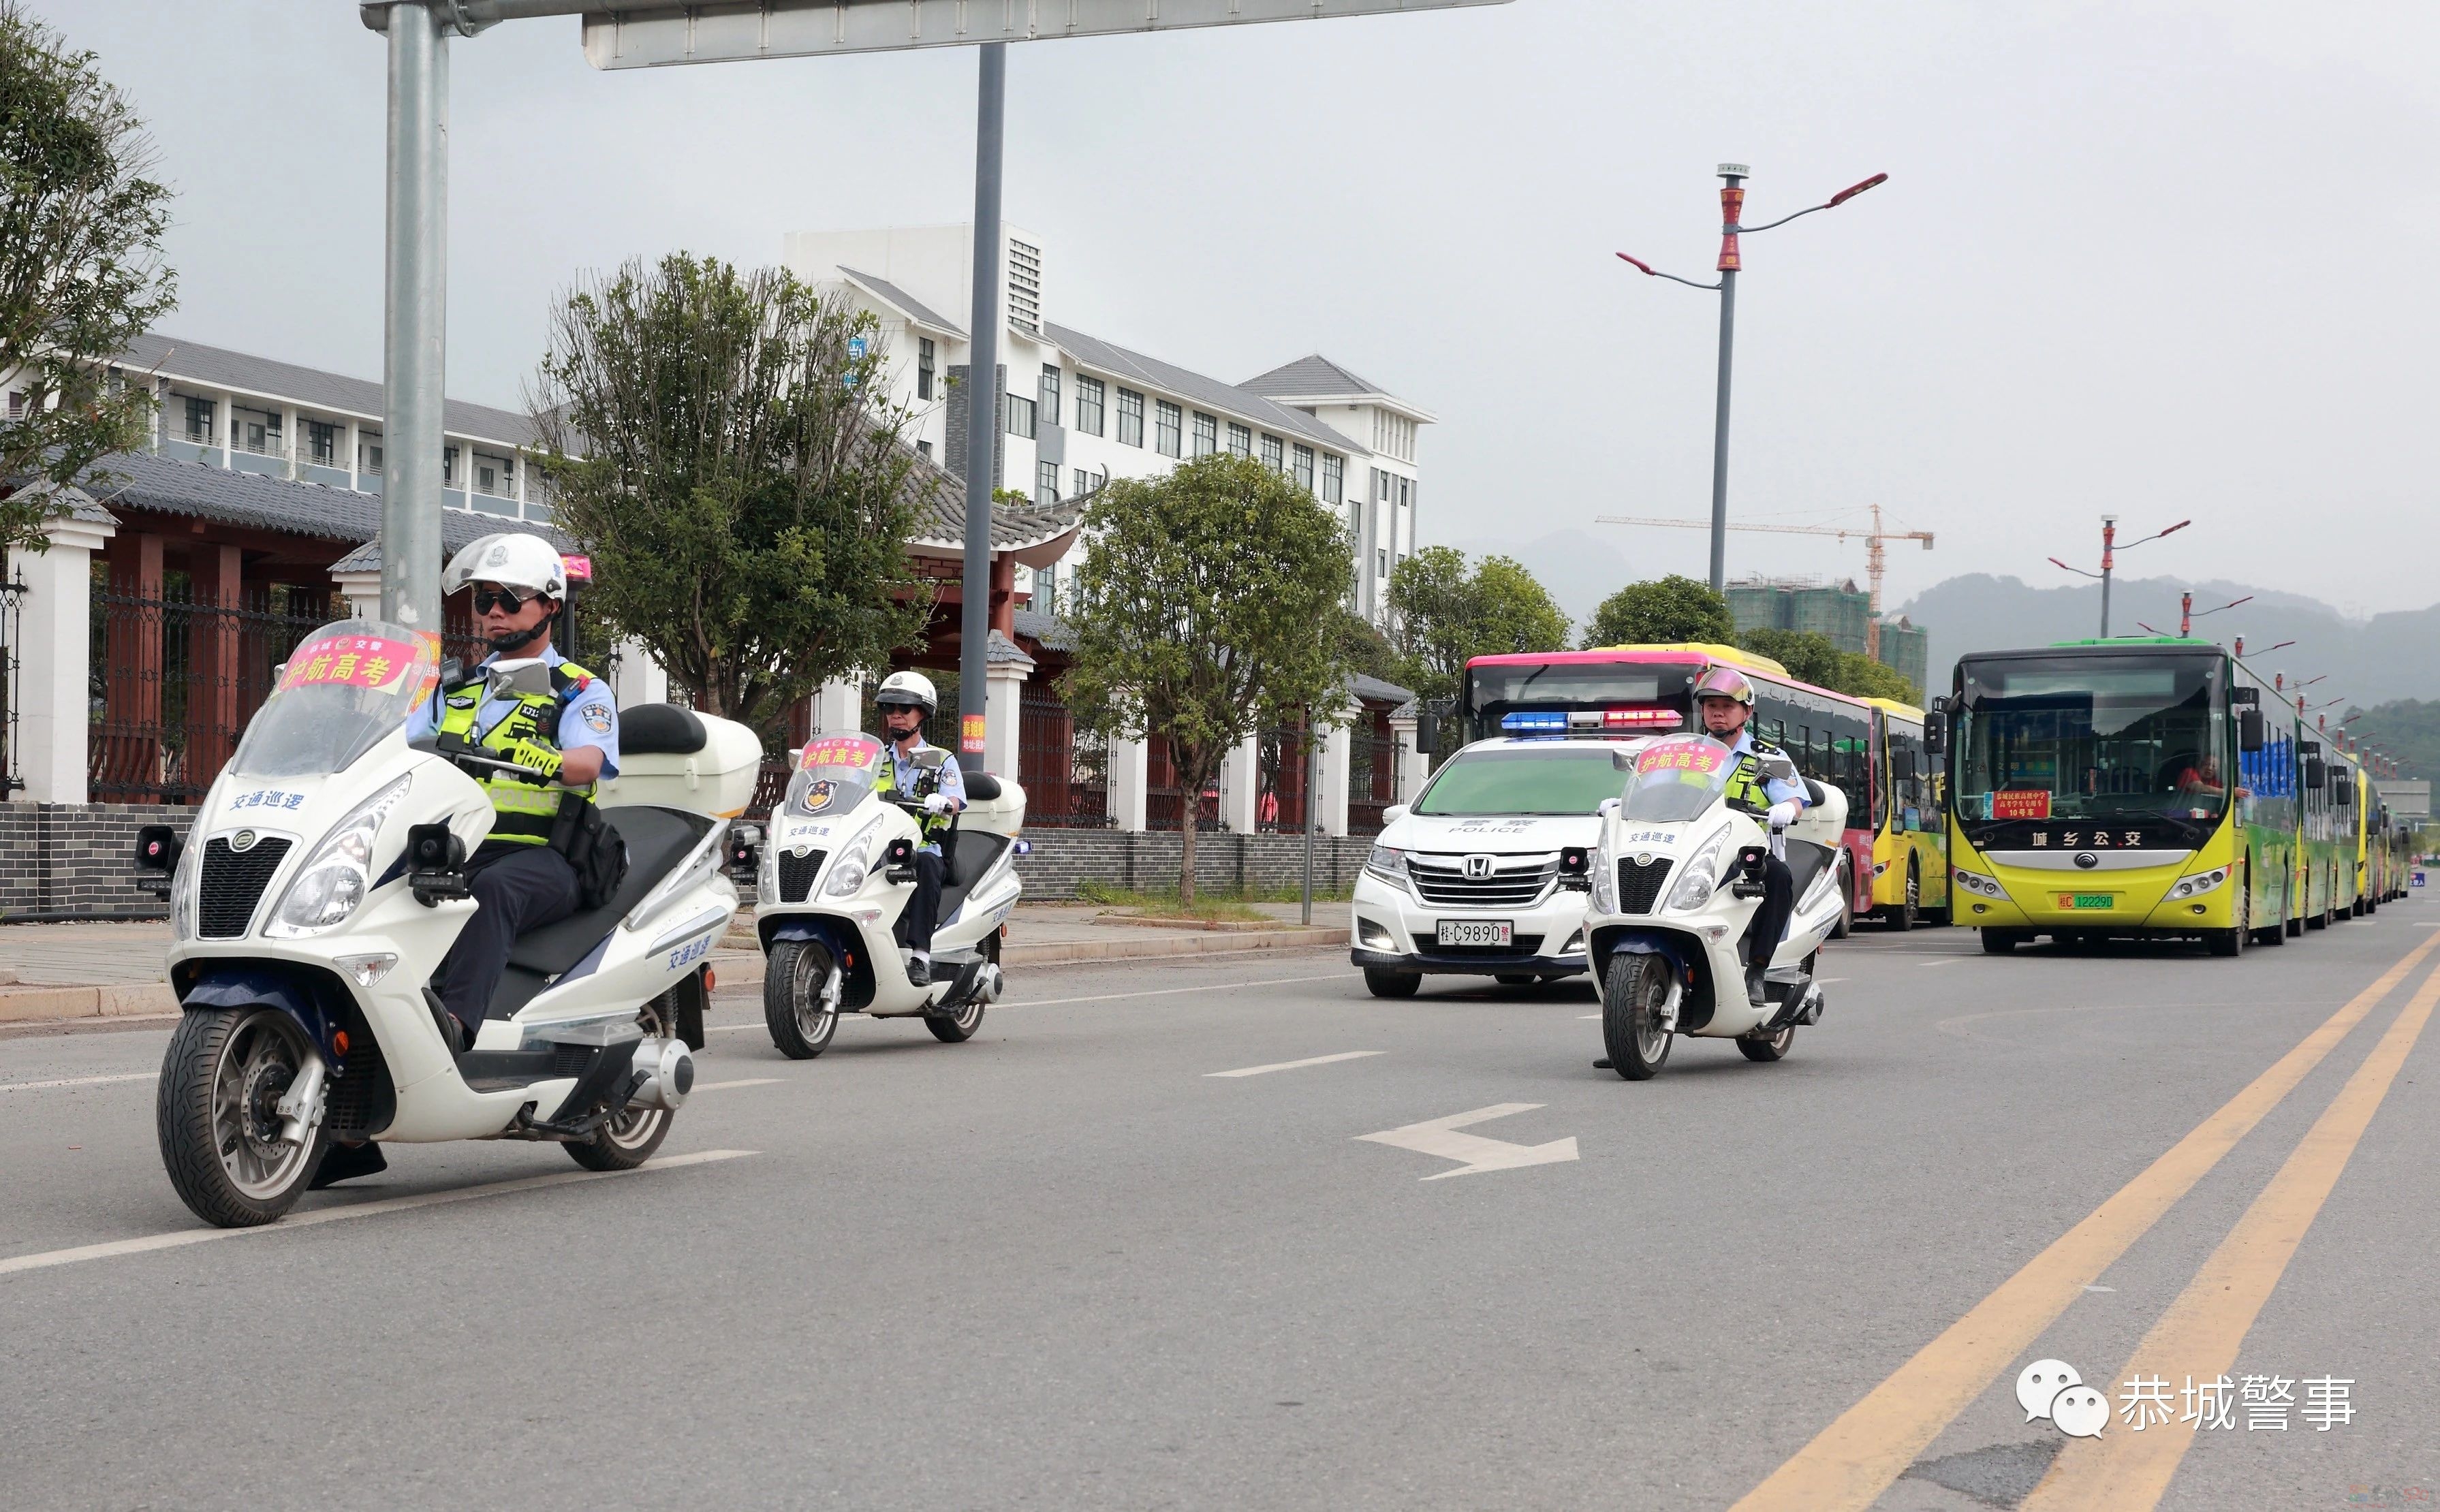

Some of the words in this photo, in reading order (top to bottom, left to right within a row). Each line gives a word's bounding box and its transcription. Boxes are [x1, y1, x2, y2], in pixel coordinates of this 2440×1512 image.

[355, 640, 383, 651] 交警
[283, 652, 390, 689] 护航高考
[804, 748, 866, 768] 护航高考
[1641, 752, 1712, 772] 护航高考
[229, 790, 304, 810] 交通巡逻
[490, 787, 559, 808] POLICE
[2009, 808, 2035, 817] 10号车
[788, 825, 830, 837] 交通巡逻
[1629, 832, 1675, 844] 交通巡逻
[2032, 831, 2141, 847] 城乡公交
[666, 934, 711, 972] 交通巡逻
